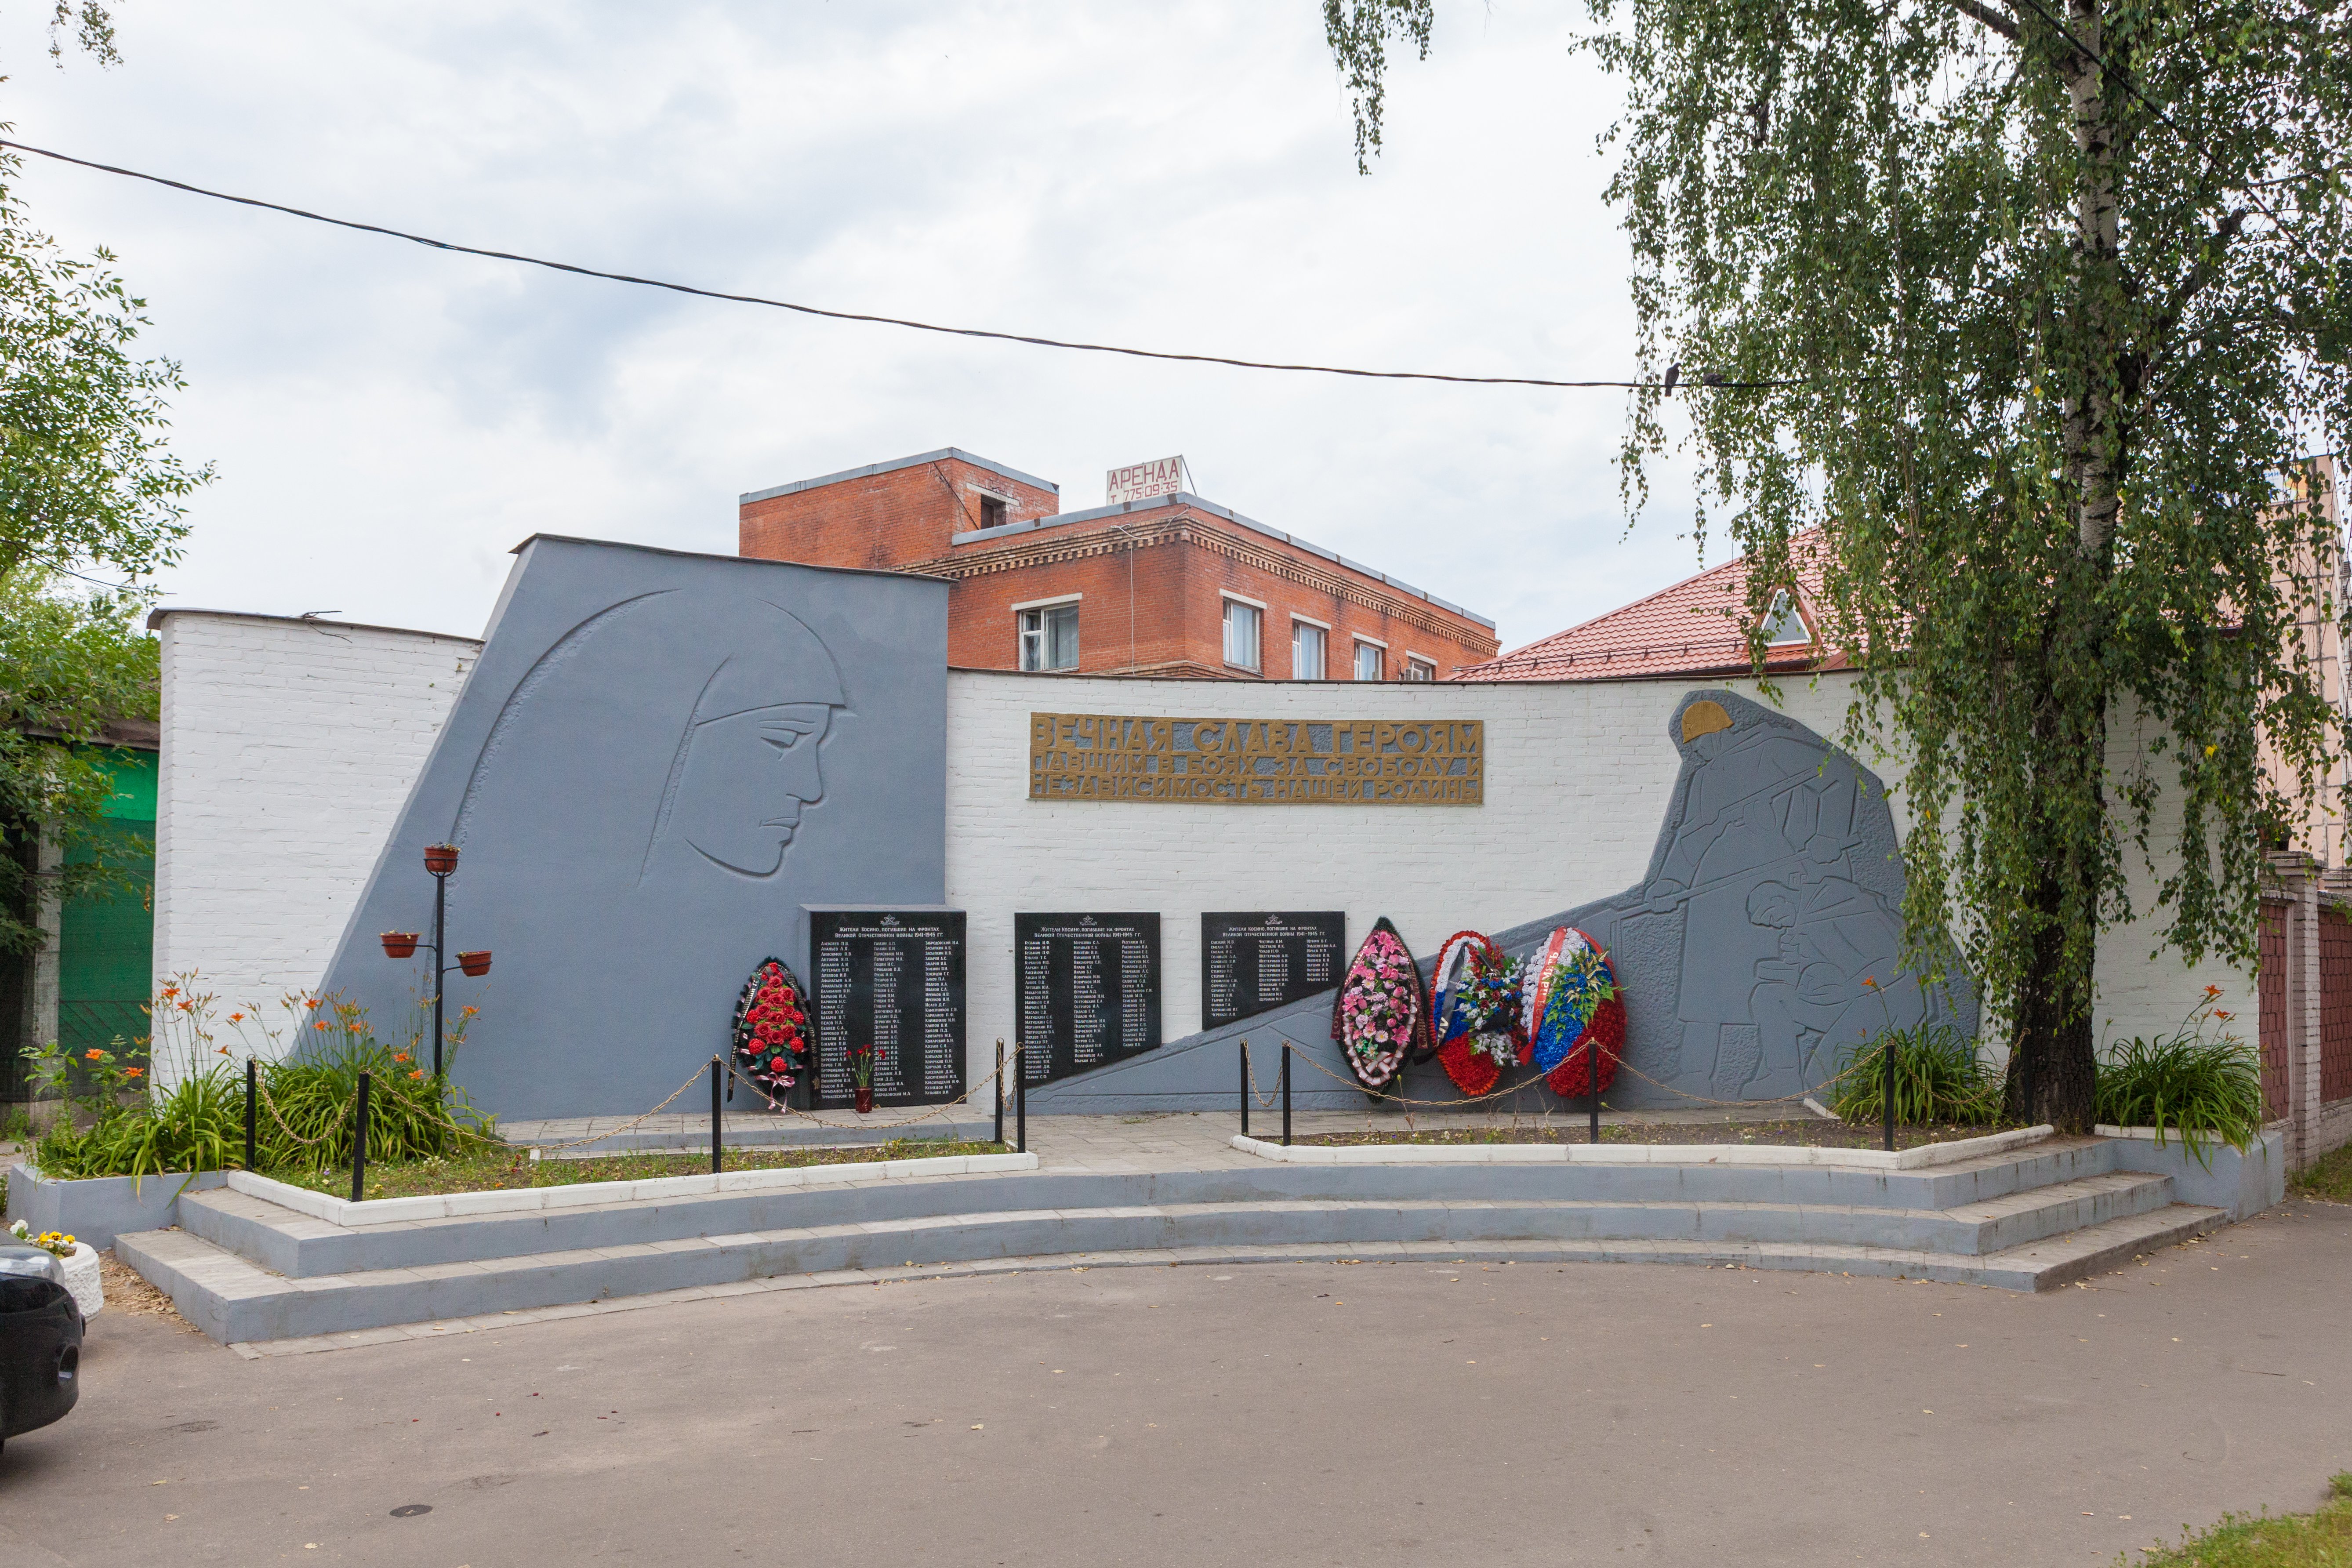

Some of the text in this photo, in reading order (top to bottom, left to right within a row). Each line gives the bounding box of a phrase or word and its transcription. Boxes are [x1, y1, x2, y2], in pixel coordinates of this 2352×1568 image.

[1109, 458, 1180, 491] АРЕНДА
[1124, 480, 1178, 501] 775-09-35
[1031, 715, 1482, 754] ВЕЧНАЯ СЛАВА ГЕРОЯМ
[1031, 750, 1482, 777] ПАВШИМ В БОЯХ ЗА СВОБОДУ И
[1031, 773, 1265, 798] НЕЗАВИСИМОСТЬ
[1278, 779, 1361, 799] НАШЕЙ
